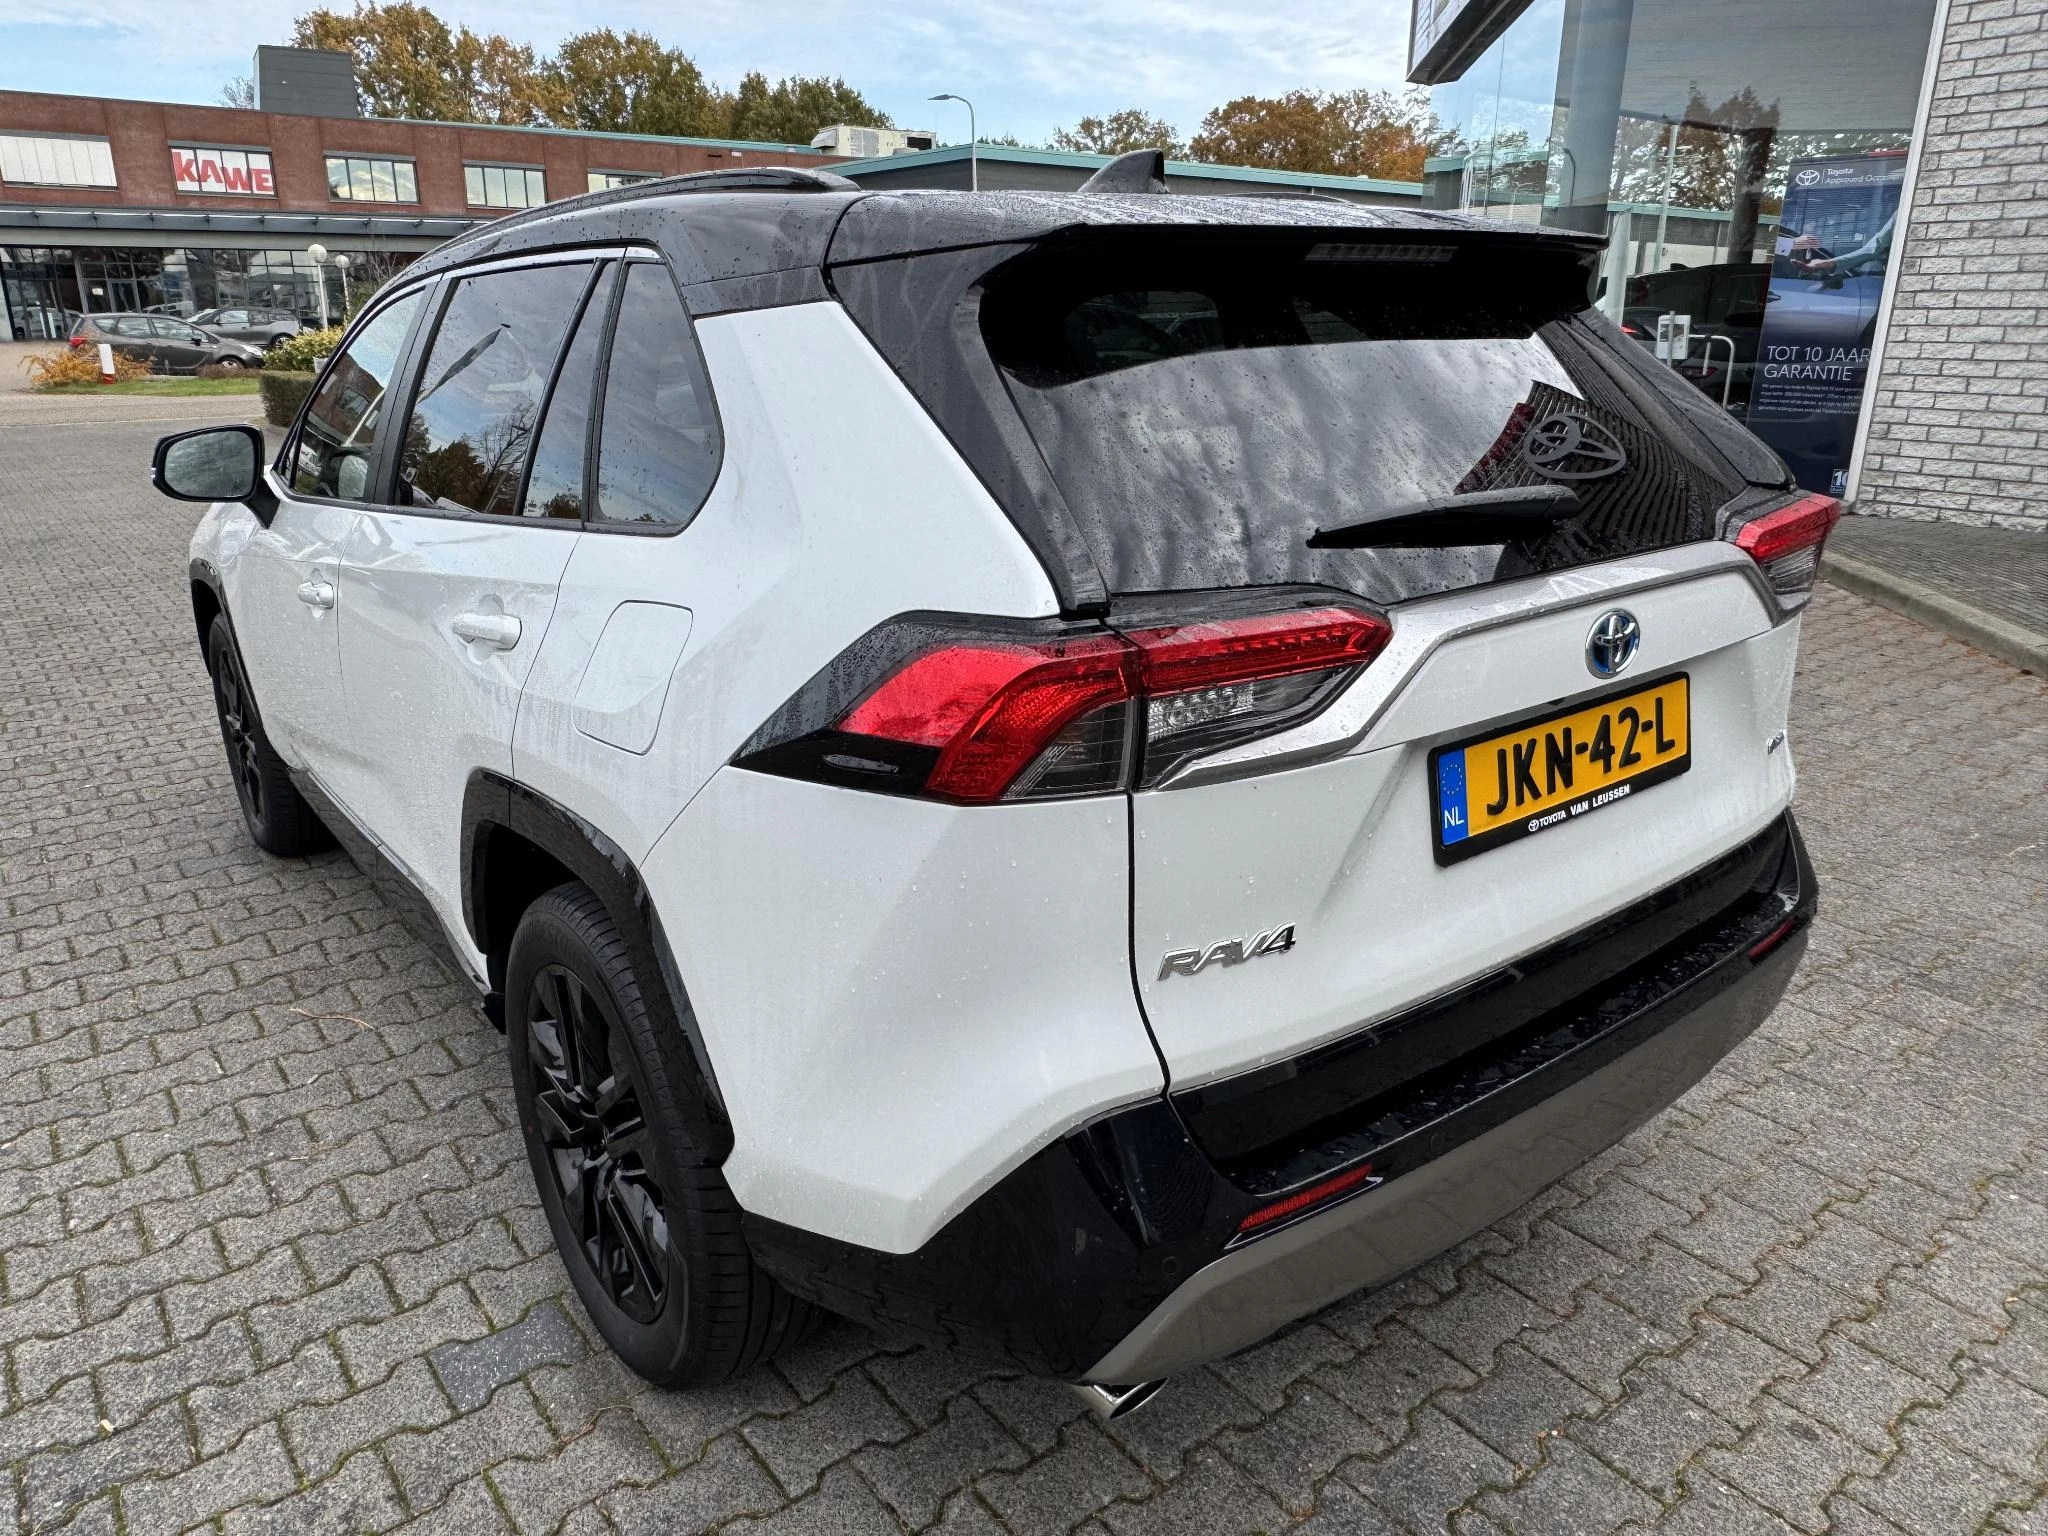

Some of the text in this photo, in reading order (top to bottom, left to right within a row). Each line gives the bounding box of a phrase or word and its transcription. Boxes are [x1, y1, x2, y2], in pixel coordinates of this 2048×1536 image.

[1827, 168, 1854, 177] Toyota
[1767, 345, 1871, 363] TOT 10 JAAR
[1764, 363, 1853, 381] GARANTIE
[1486, 697, 1675, 816] JKN-42-L
[1540, 784, 1630, 827] TOYOTA VAN LEUSSEN
[1444, 806, 1464, 829] NL
[1157, 921, 1297, 982] RAV4
